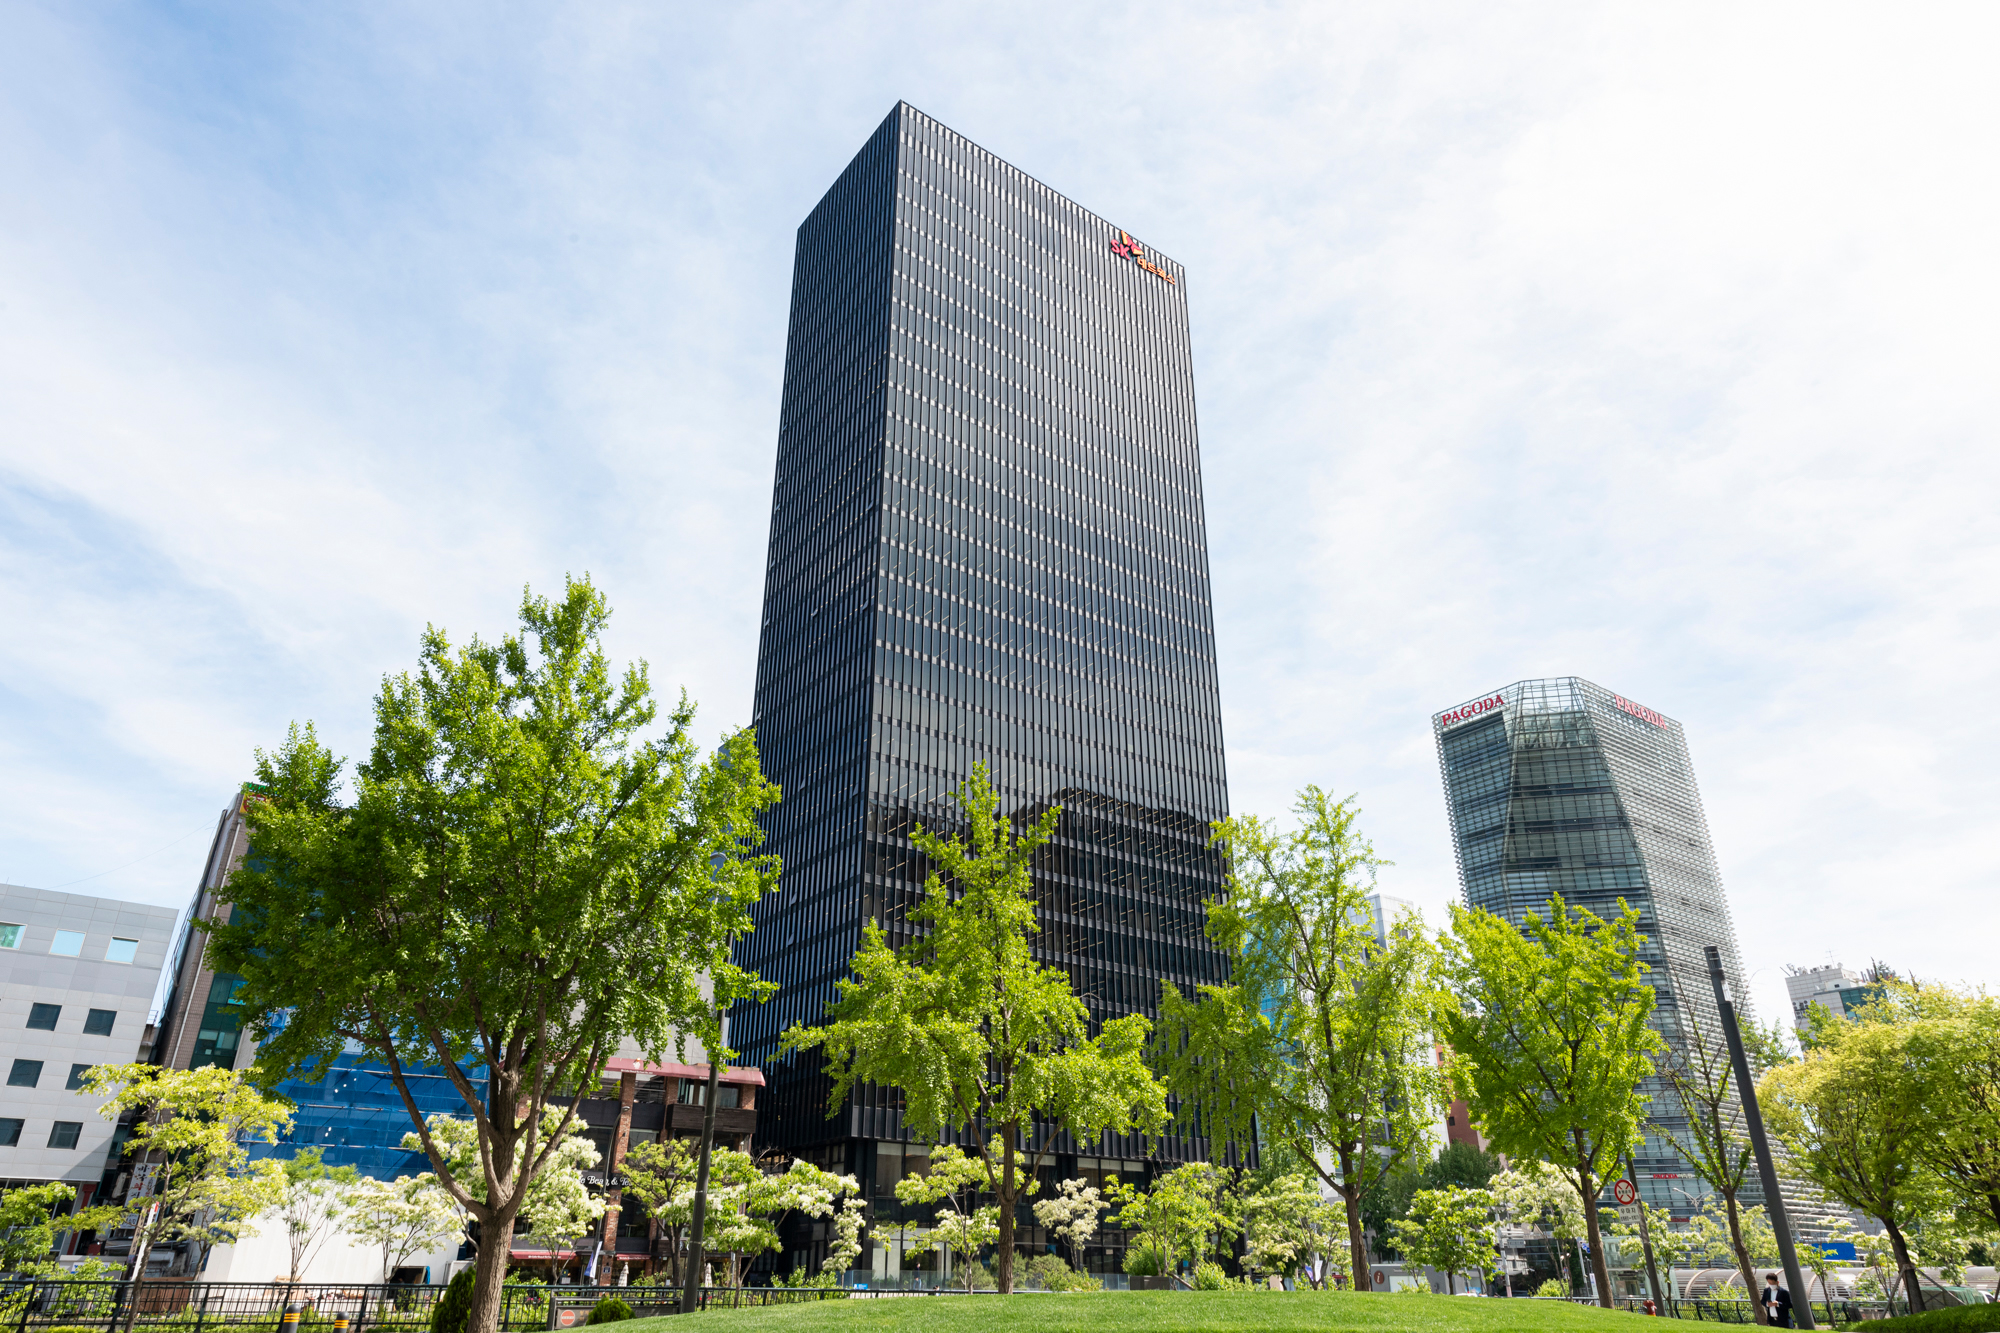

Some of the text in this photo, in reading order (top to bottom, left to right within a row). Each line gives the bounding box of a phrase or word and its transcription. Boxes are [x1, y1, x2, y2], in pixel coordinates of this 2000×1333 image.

[1111, 239, 1176, 285] SK 네트웍스
[1441, 694, 1505, 727] PAGODA
[1614, 694, 1667, 729] PAGODA
